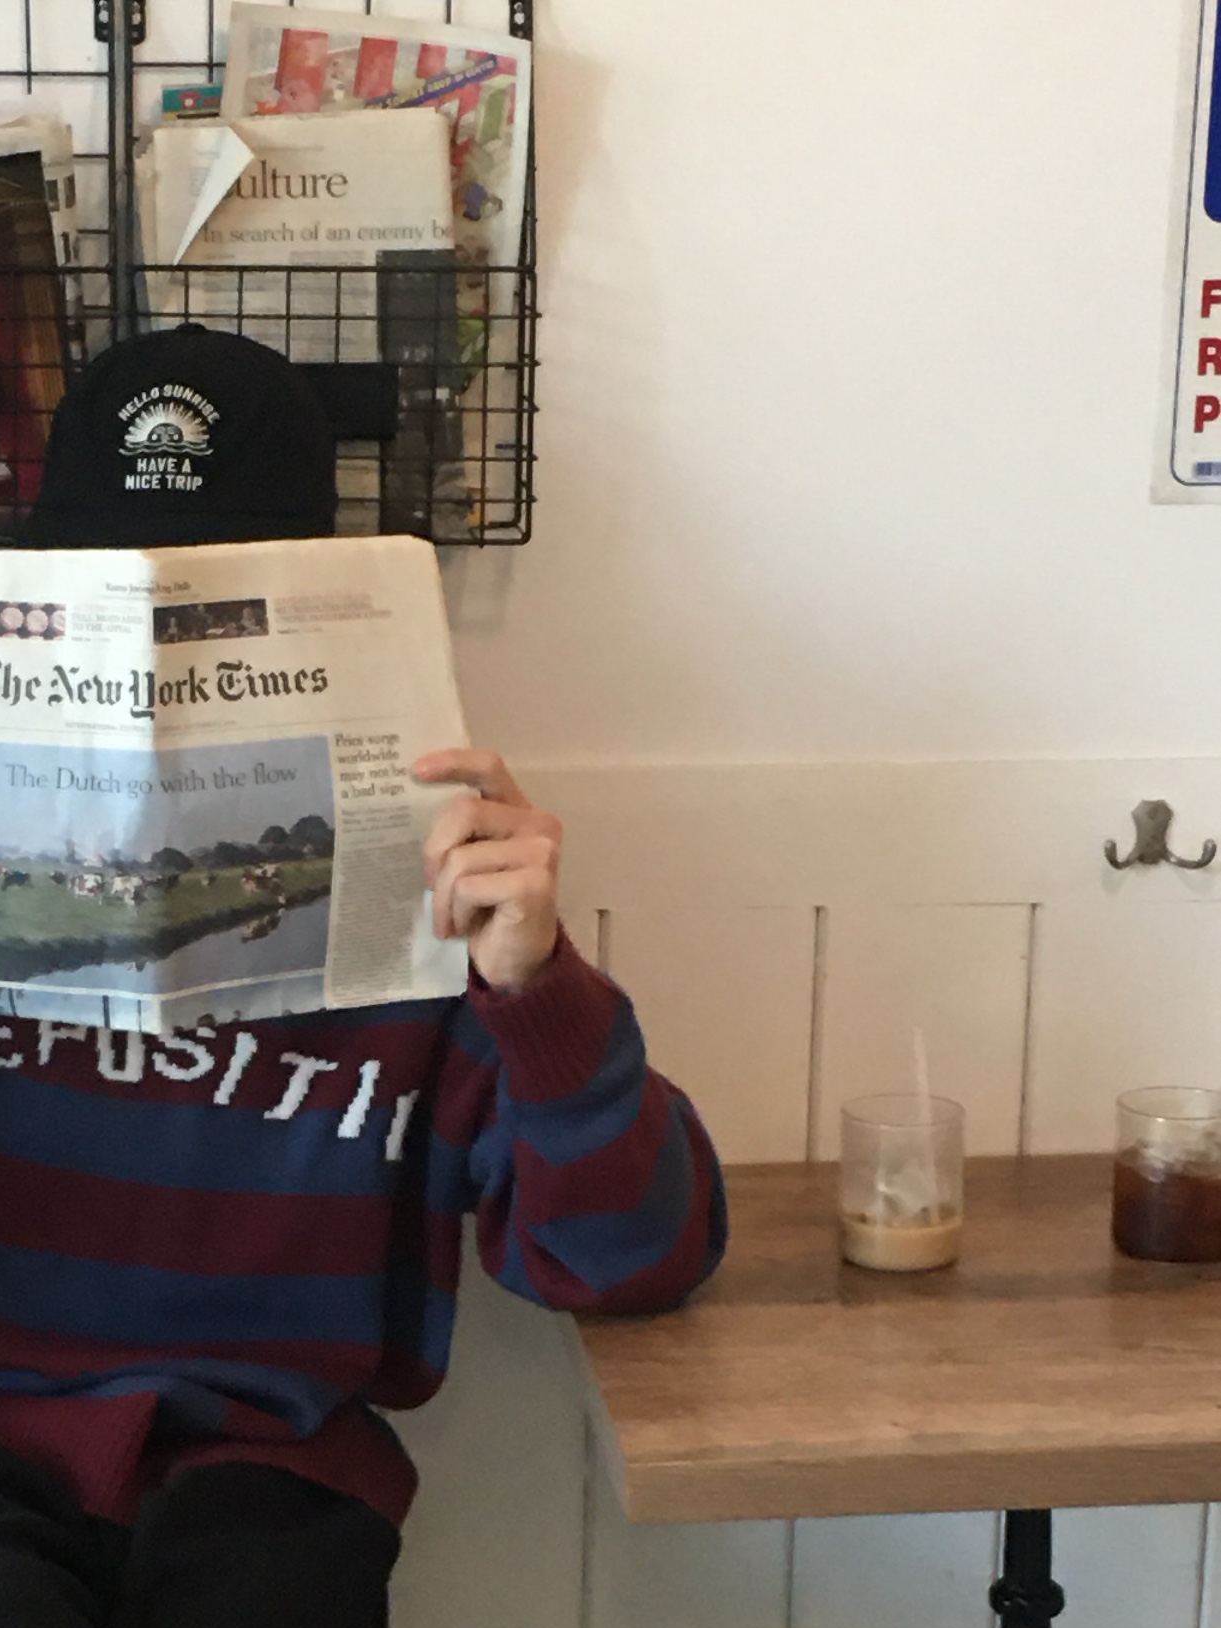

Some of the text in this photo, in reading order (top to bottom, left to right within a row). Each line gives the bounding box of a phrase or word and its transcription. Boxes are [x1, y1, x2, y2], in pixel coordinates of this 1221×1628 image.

[227, 159, 349, 200] ulture
[230, 222, 294, 243] search
[300, 220, 321, 241] of
[326, 227, 351, 241] an
[358, 226, 426, 244] enemy
[118, 384, 221, 425] HELLO SUNRISE
[137, 458, 192, 473] HAVE A
[125, 474, 203, 491] NICE TRIP
[47, 664, 124, 707] New
[129, 665, 211, 720] York
[217, 659, 328, 700] Times
[337, 750, 400, 763] worldwide
[5, 762, 297, 799] The Dutch go with the flow
[340, 764, 407, 782] may not be
[341, 783, 404, 798] a bad sign
